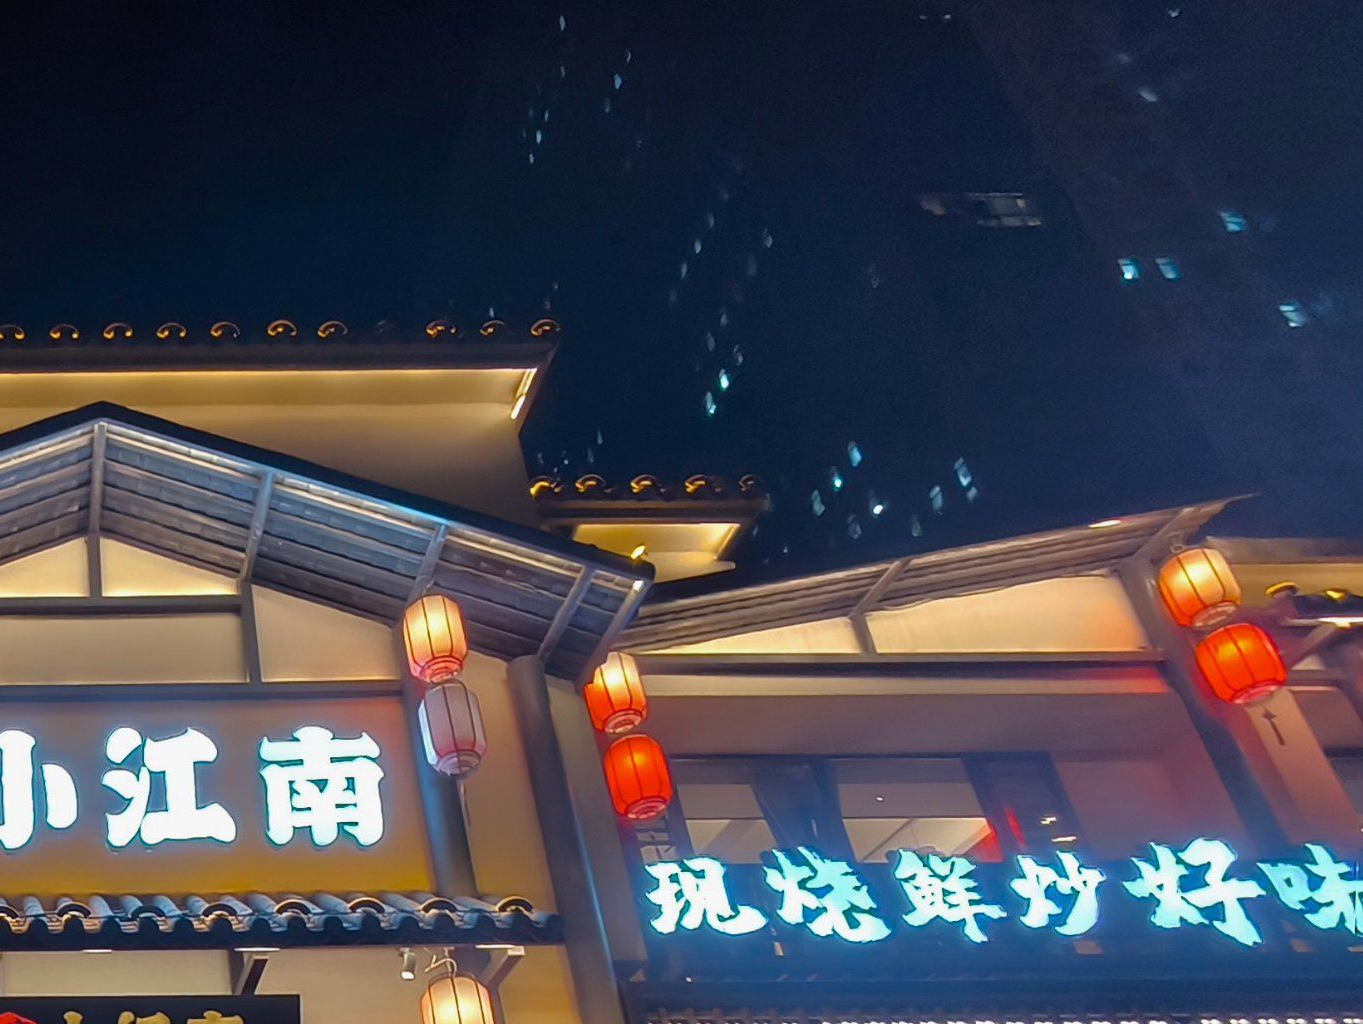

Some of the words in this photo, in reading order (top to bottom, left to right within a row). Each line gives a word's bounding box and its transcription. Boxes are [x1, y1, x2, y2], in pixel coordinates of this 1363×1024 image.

[644, 837, 1363, 947] 现烧鲜炒好味
